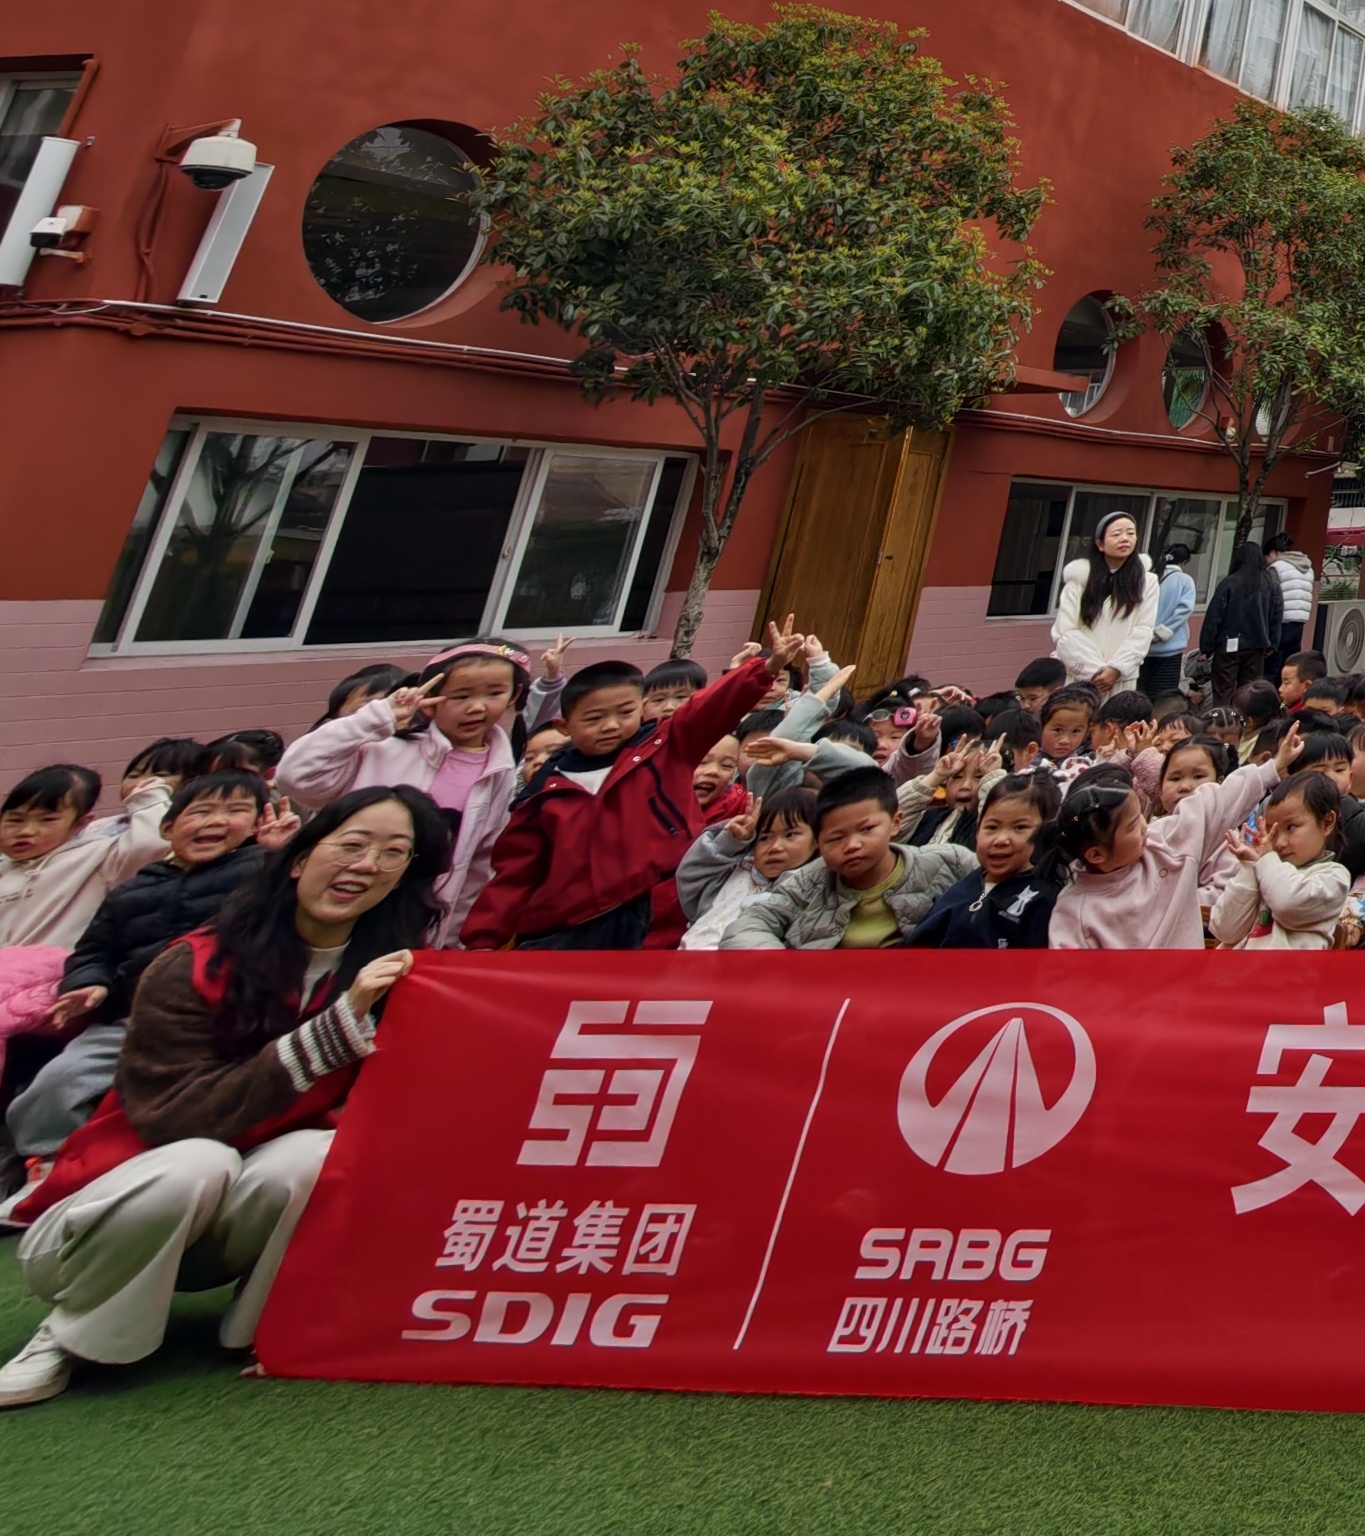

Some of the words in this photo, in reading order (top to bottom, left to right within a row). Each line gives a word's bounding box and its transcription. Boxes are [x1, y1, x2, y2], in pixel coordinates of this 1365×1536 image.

[436, 1199, 697, 1276] 蜀道集团
[855, 1228, 1052, 1282] SABG
[403, 1290, 669, 1348] SDIG
[827, 1297, 1034, 1356] 四川路桥
